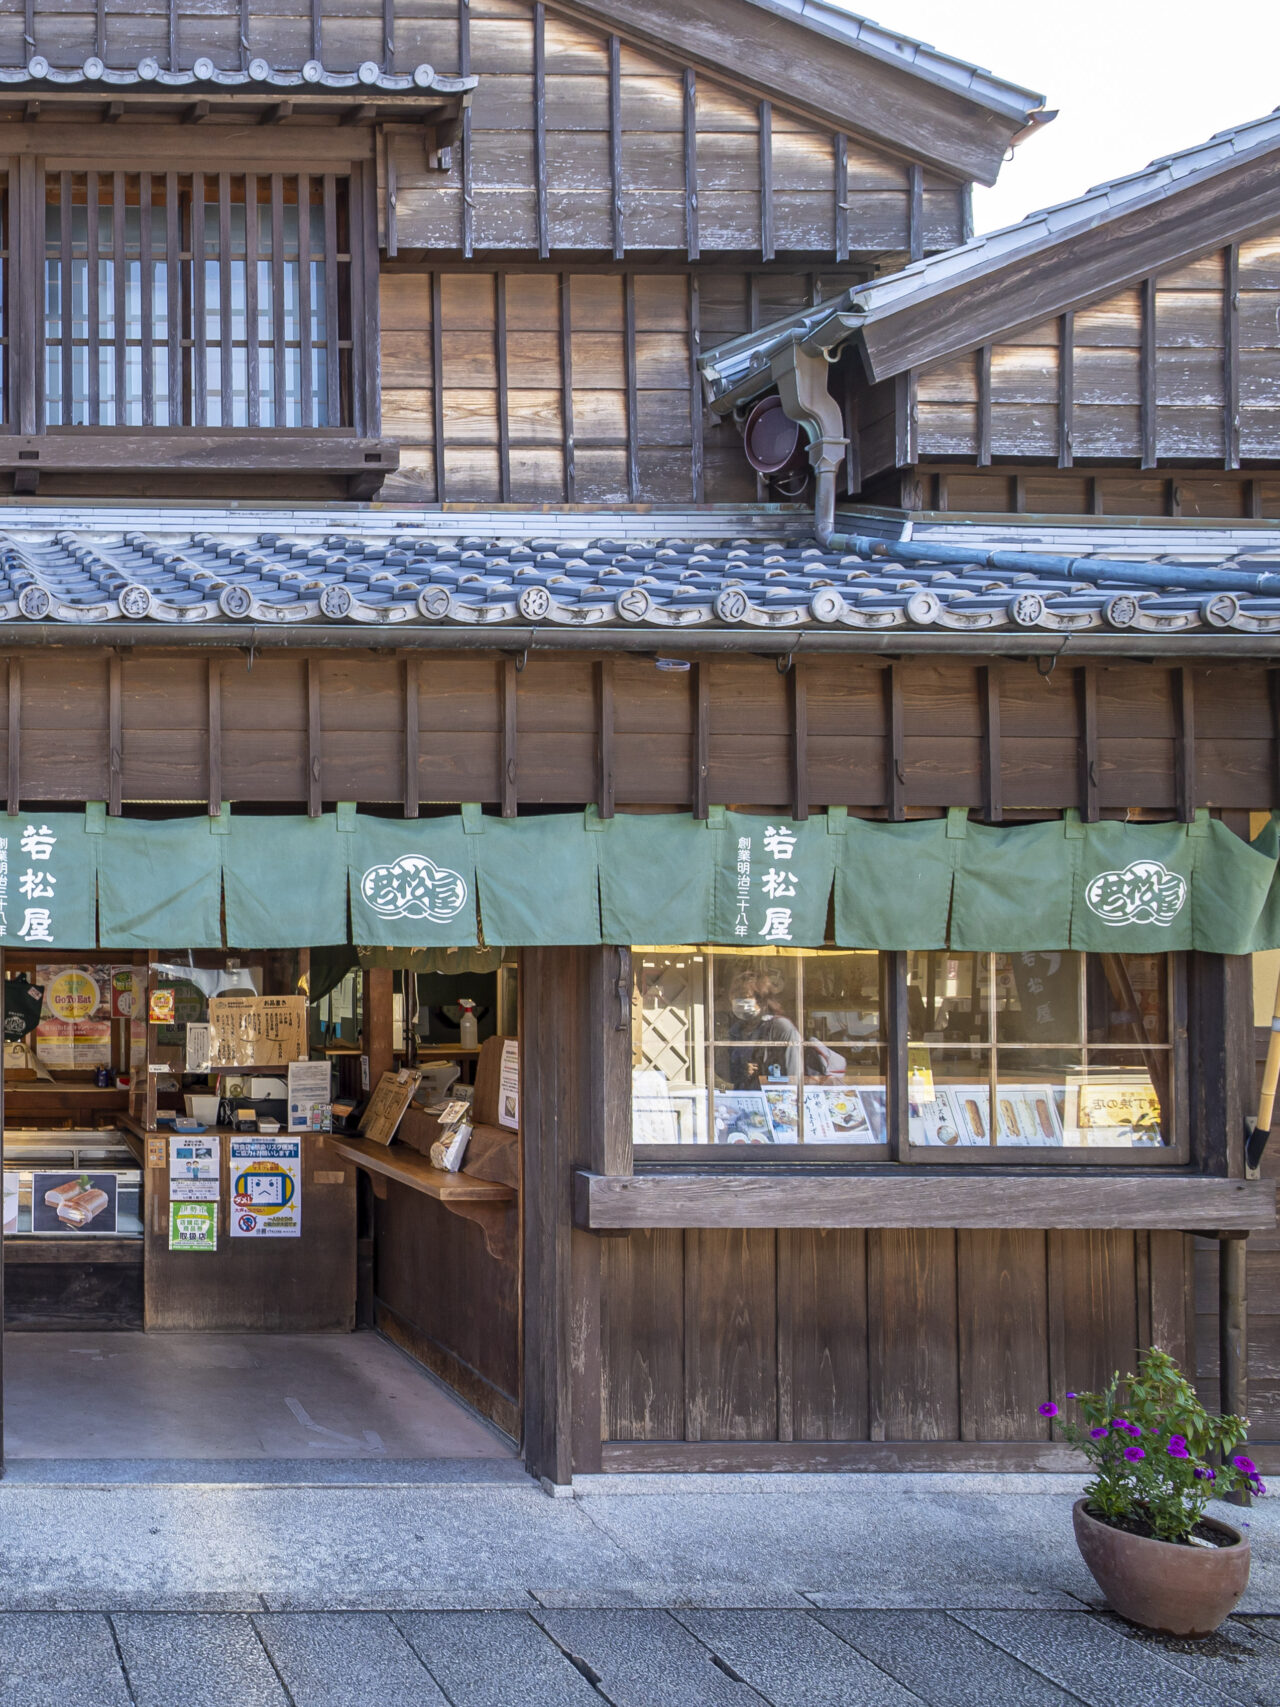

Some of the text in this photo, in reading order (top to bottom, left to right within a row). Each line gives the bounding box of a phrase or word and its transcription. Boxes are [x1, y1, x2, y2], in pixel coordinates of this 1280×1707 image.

[17, 825, 57, 942] 若松屋
[734, 837, 751, 937] 創業明治三十八年
[758, 826, 799, 941] 若松屋
[55, 995, 65, 1004] Go
[77, 995, 91, 1004] Eat
